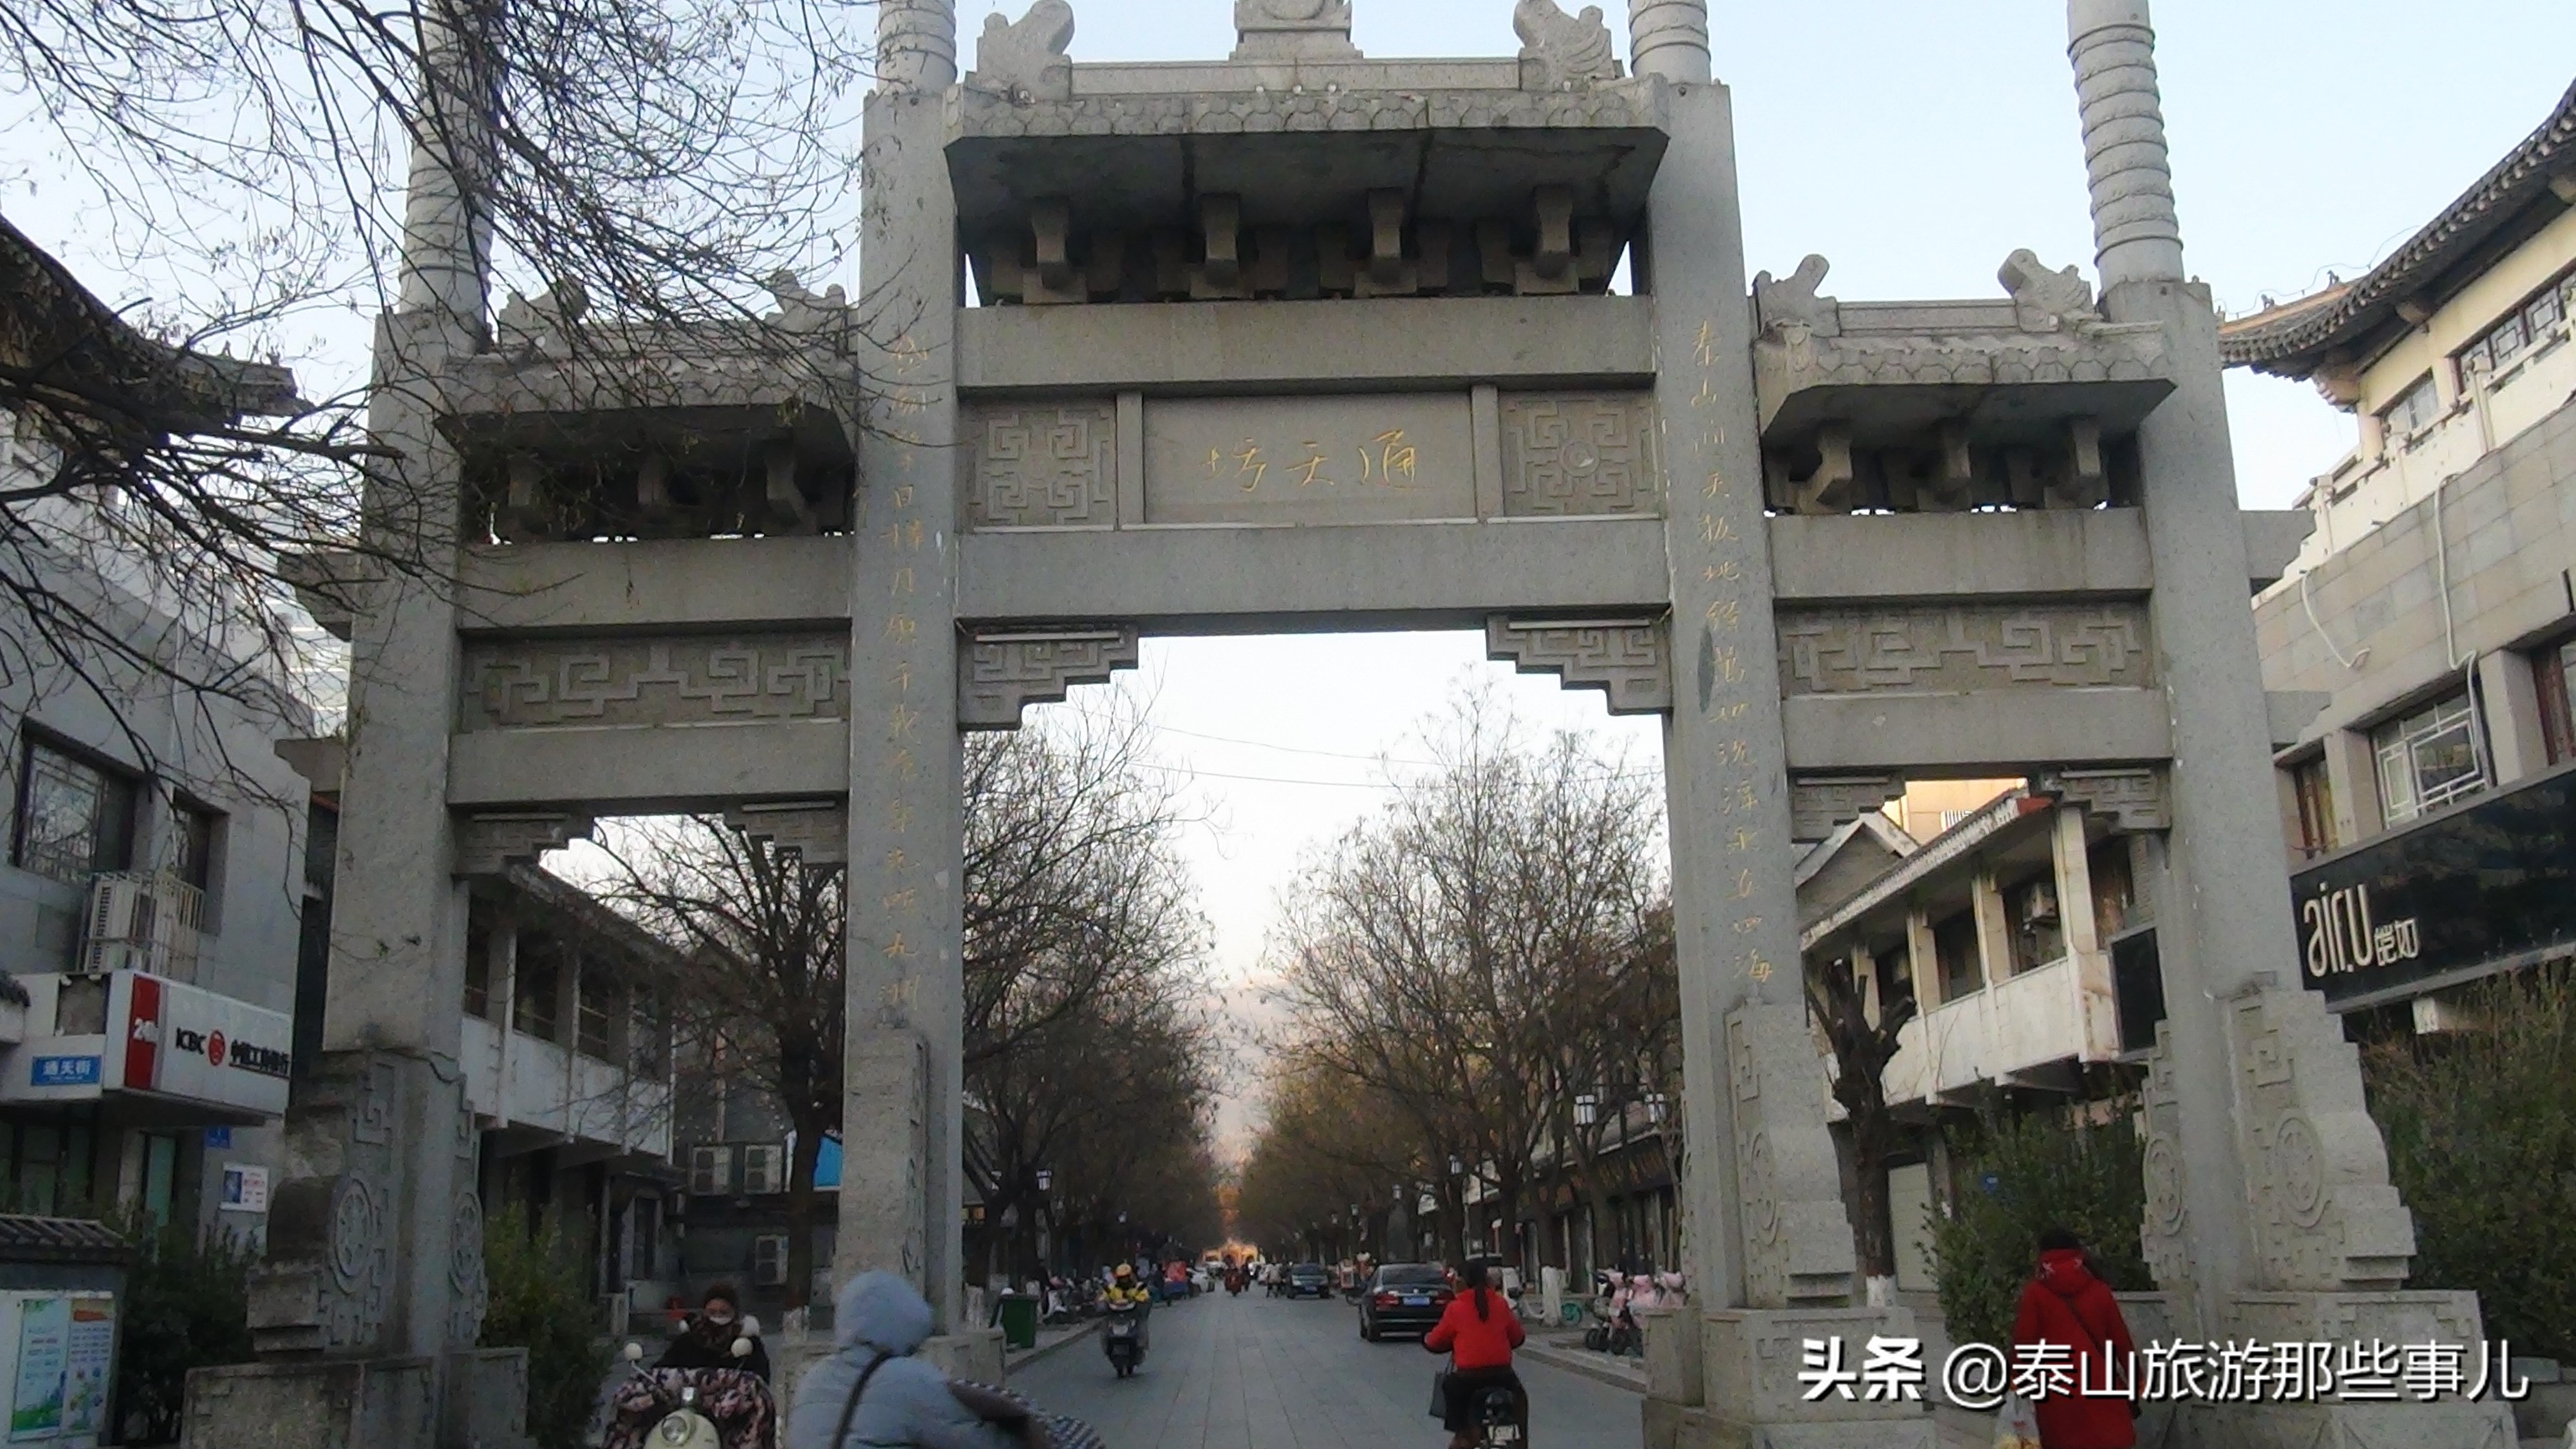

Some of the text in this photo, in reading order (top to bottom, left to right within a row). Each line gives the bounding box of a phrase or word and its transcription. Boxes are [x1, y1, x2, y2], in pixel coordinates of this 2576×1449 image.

[175, 1026, 207, 1055] ICBC
[43, 1058, 91, 1076] 通天街
